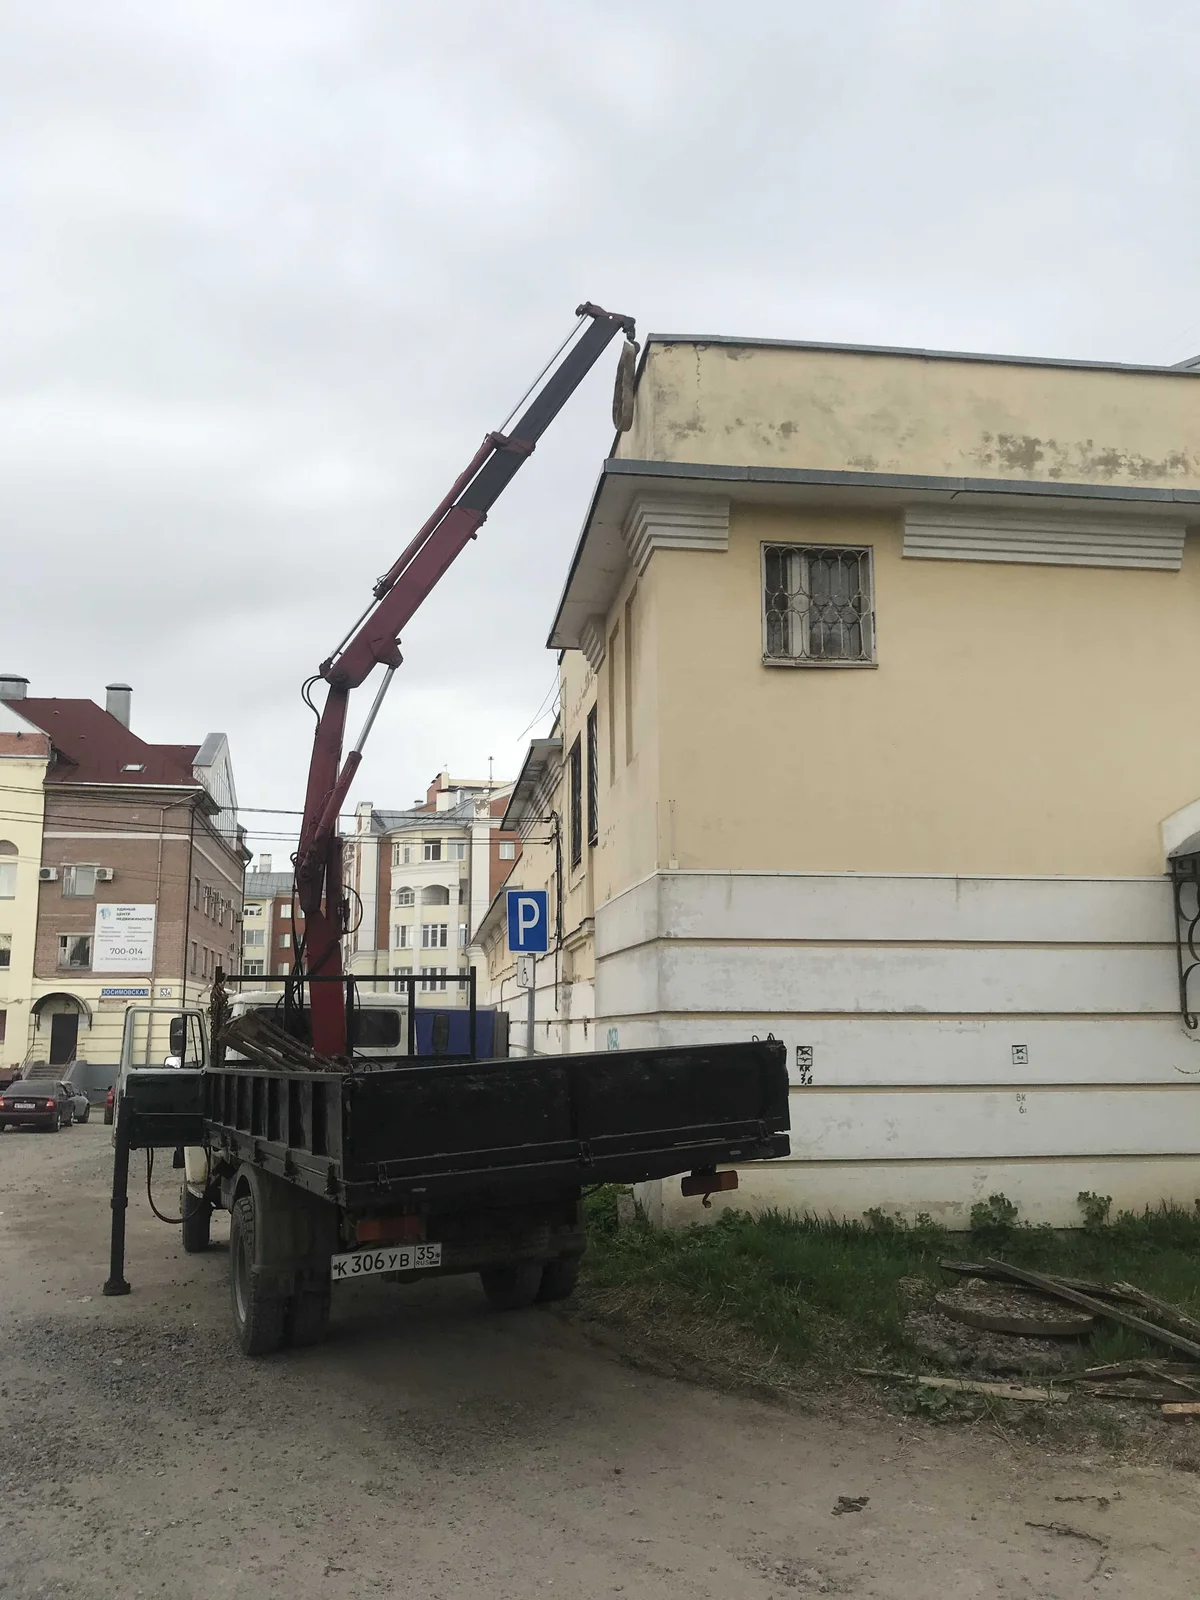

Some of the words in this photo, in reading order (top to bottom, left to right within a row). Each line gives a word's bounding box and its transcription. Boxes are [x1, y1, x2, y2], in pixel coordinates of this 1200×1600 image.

[518, 897, 540, 945] P
[109, 947, 143, 955] 700-014
[417, 1246, 435, 1260] 35
